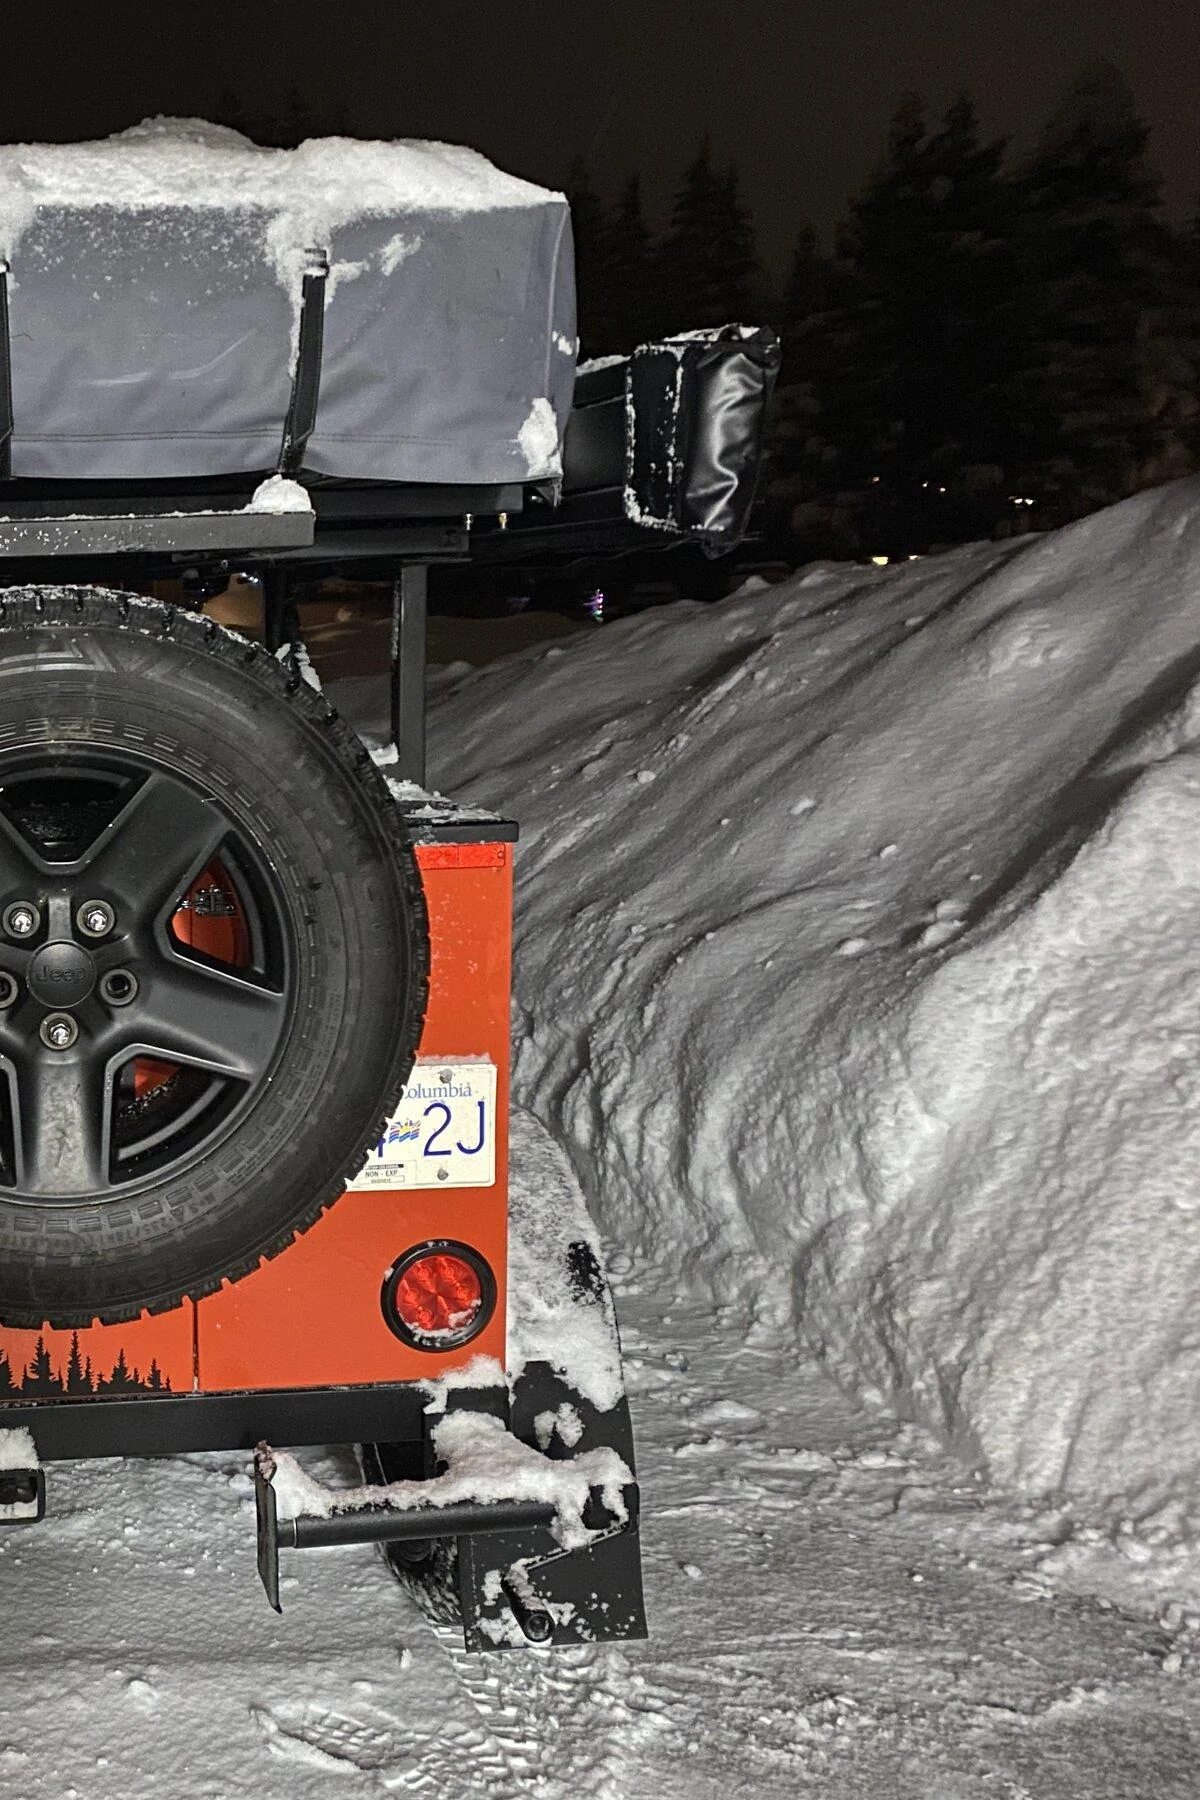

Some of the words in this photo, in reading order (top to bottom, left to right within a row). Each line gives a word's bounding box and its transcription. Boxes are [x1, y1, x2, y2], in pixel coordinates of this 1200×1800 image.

[35, 965, 87, 983] Jeep
[405, 1083, 473, 1099] olumbia
[365, 1170, 379, 1178] NON
[385, 1169, 398, 1177] EXP
